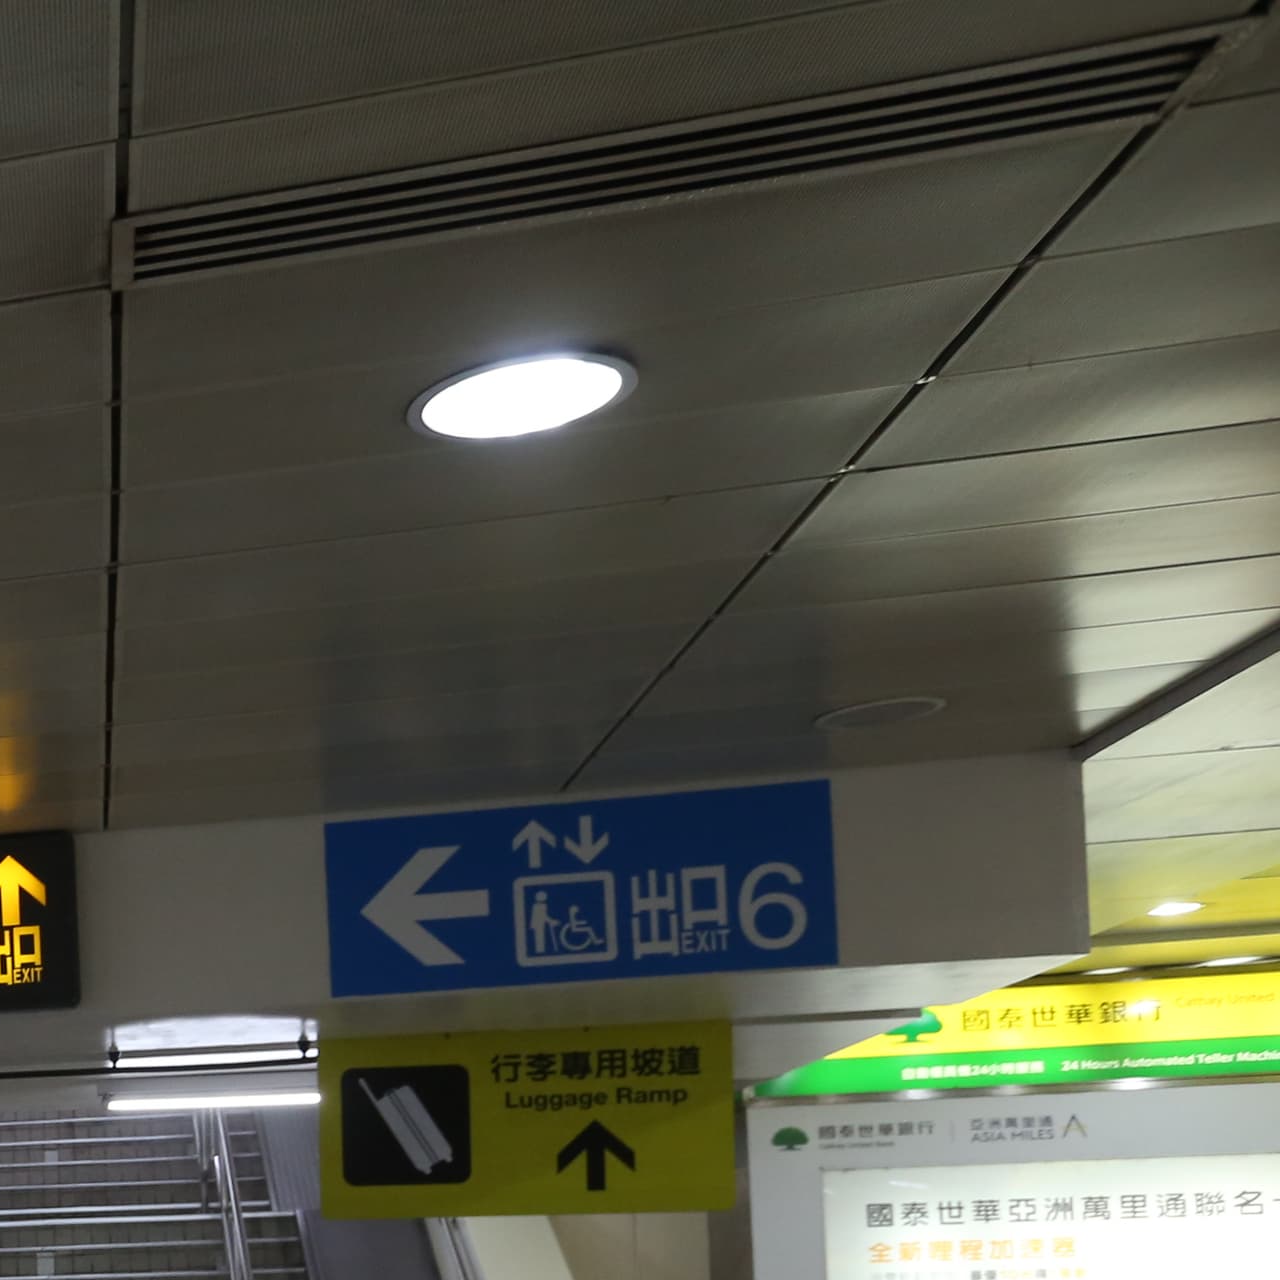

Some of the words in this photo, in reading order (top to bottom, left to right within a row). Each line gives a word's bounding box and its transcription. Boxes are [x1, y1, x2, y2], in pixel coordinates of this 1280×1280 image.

[631, 865, 729, 960] 出口
[739, 861, 808, 951] 6
[681, 928, 730, 954] EXIT
[13, 966, 42, 985] EXIT
[491, 1045, 701, 1083] 行李專用坡道
[1061, 1058, 1079, 1072] 24
[1081, 1057, 1120, 1071] Hours
[1123, 1054, 1195, 1069] Automated
[1197, 1052, 1235, 1065] Teller
[505, 1088, 608, 1112] Luggage
[616, 1086, 689, 1108] Ramp
[971, 1131, 1007, 1143] ASIA
[1011, 1129, 1055, 1141] MILES
[866, 1190, 1280, 1228] 國泰世華亞洲萬里通聯名
